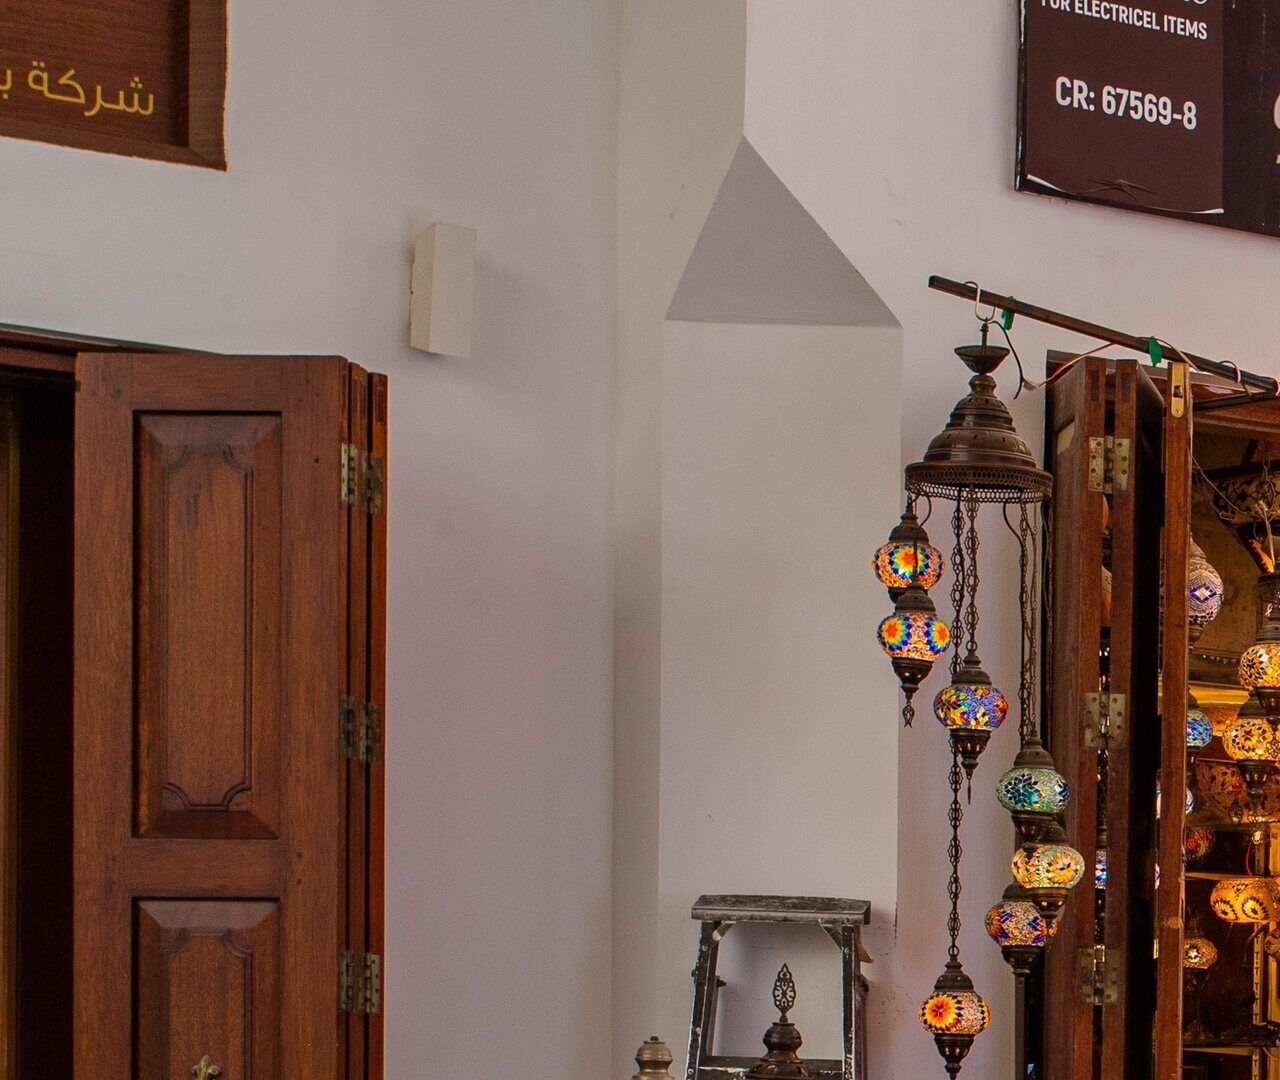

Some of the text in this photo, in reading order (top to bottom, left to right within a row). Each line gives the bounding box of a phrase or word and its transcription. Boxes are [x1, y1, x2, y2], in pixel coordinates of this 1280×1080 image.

[1075, 0, 1160, 31] ELECTRICEL
[1163, 14, 1208, 40] ITEMS
[27, 60, 154, 117] شركة
[1056, 76, 1197, 130] CR: 67569-8
